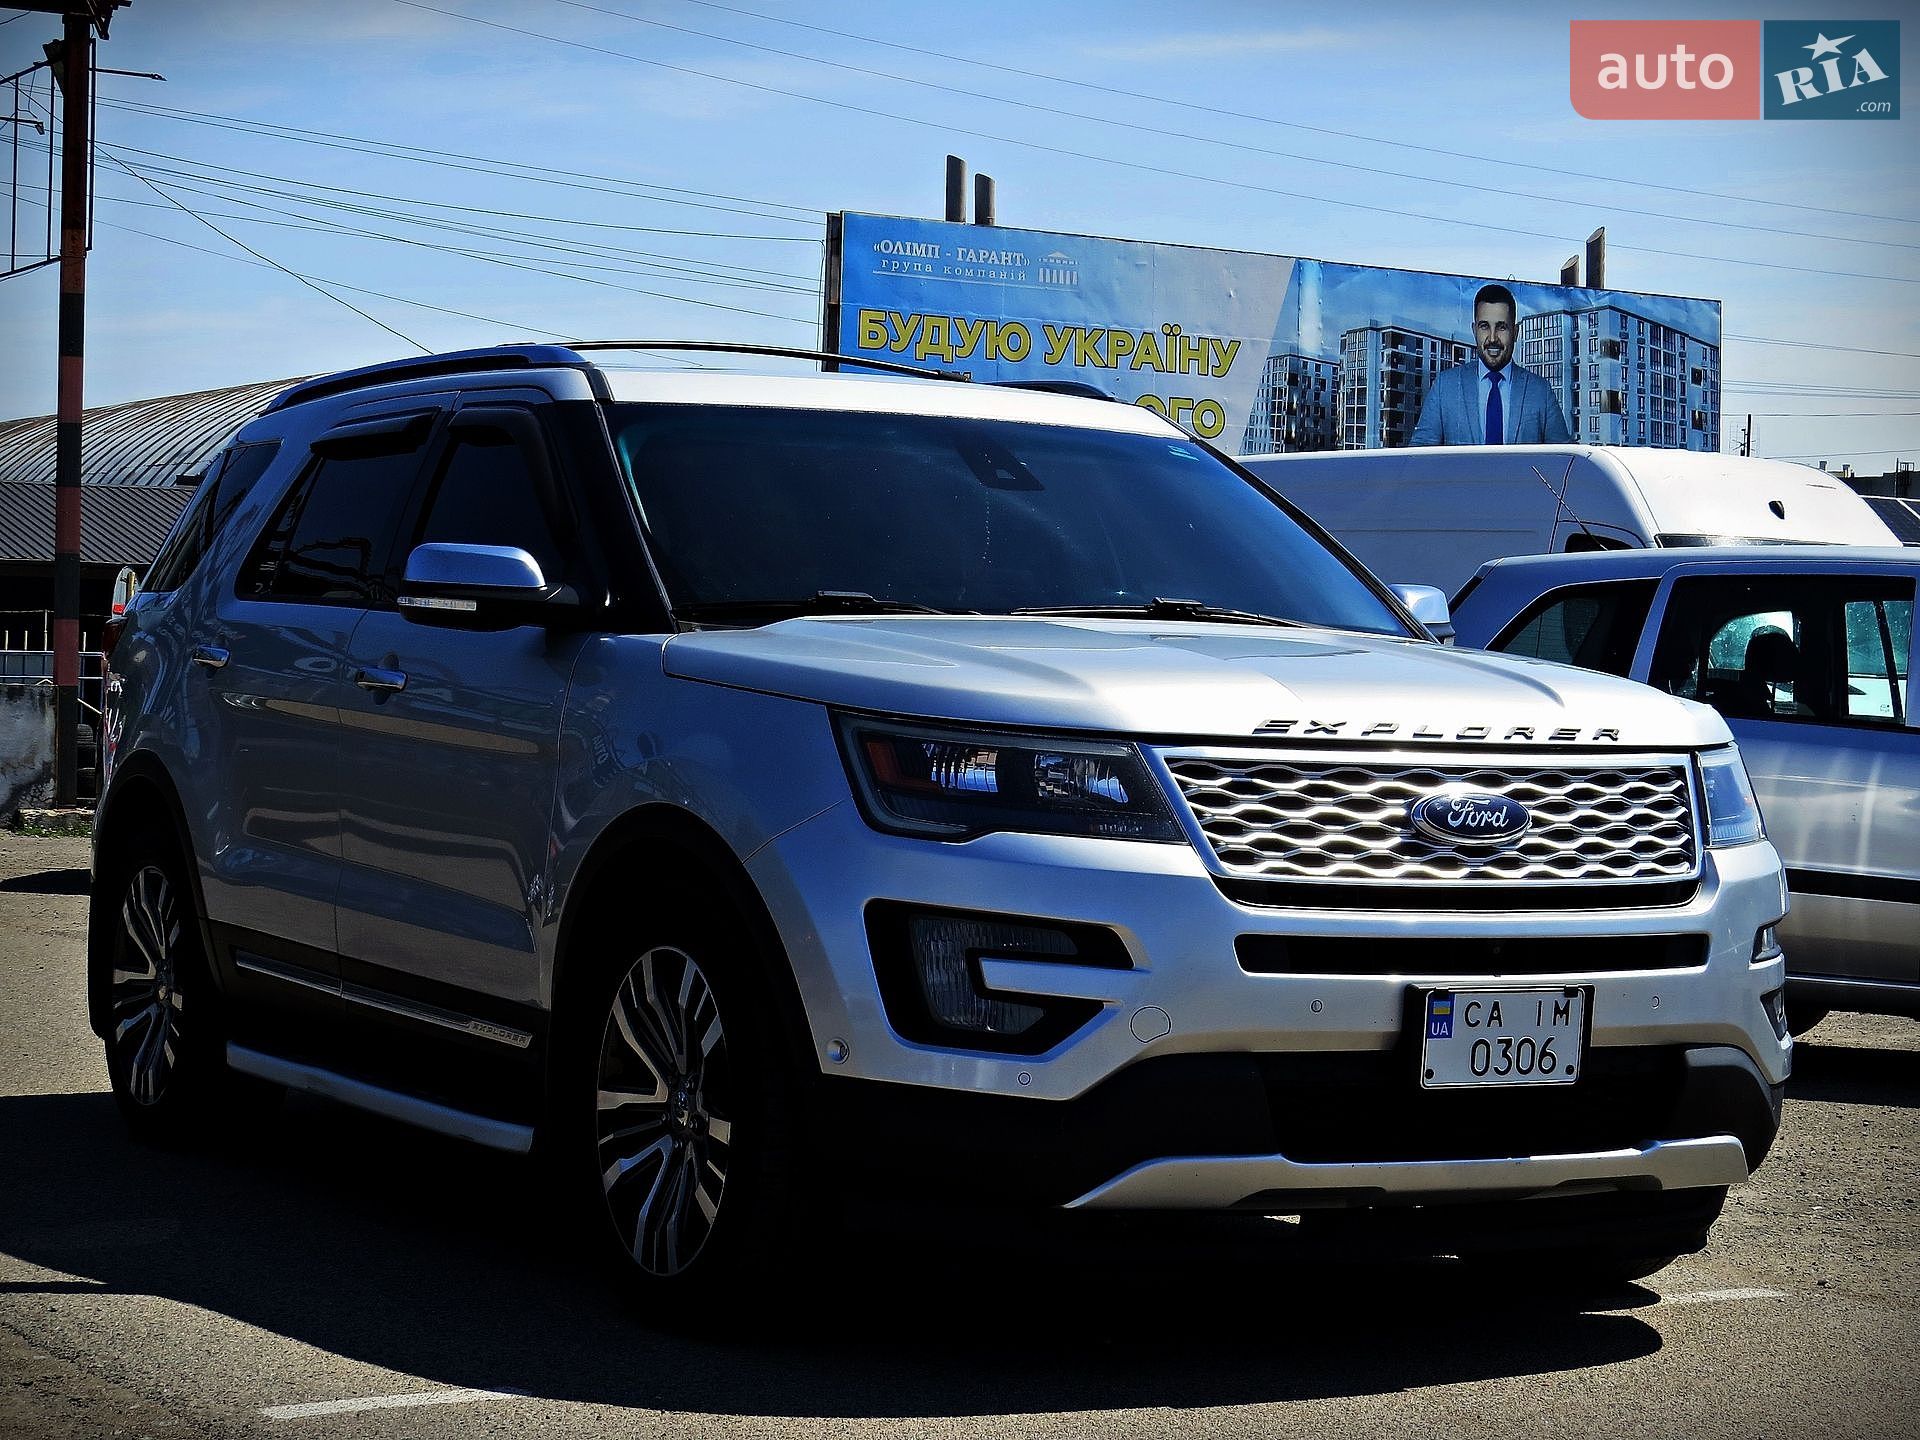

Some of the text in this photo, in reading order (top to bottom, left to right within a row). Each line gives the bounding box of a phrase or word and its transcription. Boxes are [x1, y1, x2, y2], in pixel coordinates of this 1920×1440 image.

[881, 259, 1026, 281] група компаній
[858, 308, 1241, 378] БУДУЮ УКРАЇНУ
[1252, 719, 1621, 742] EXPLORER
[1447, 799, 1509, 828] Ford
[1464, 1000, 1572, 1028] CA IM
[1431, 1021, 1449, 1036] UA
[1470, 1036, 1557, 1077] 0306
